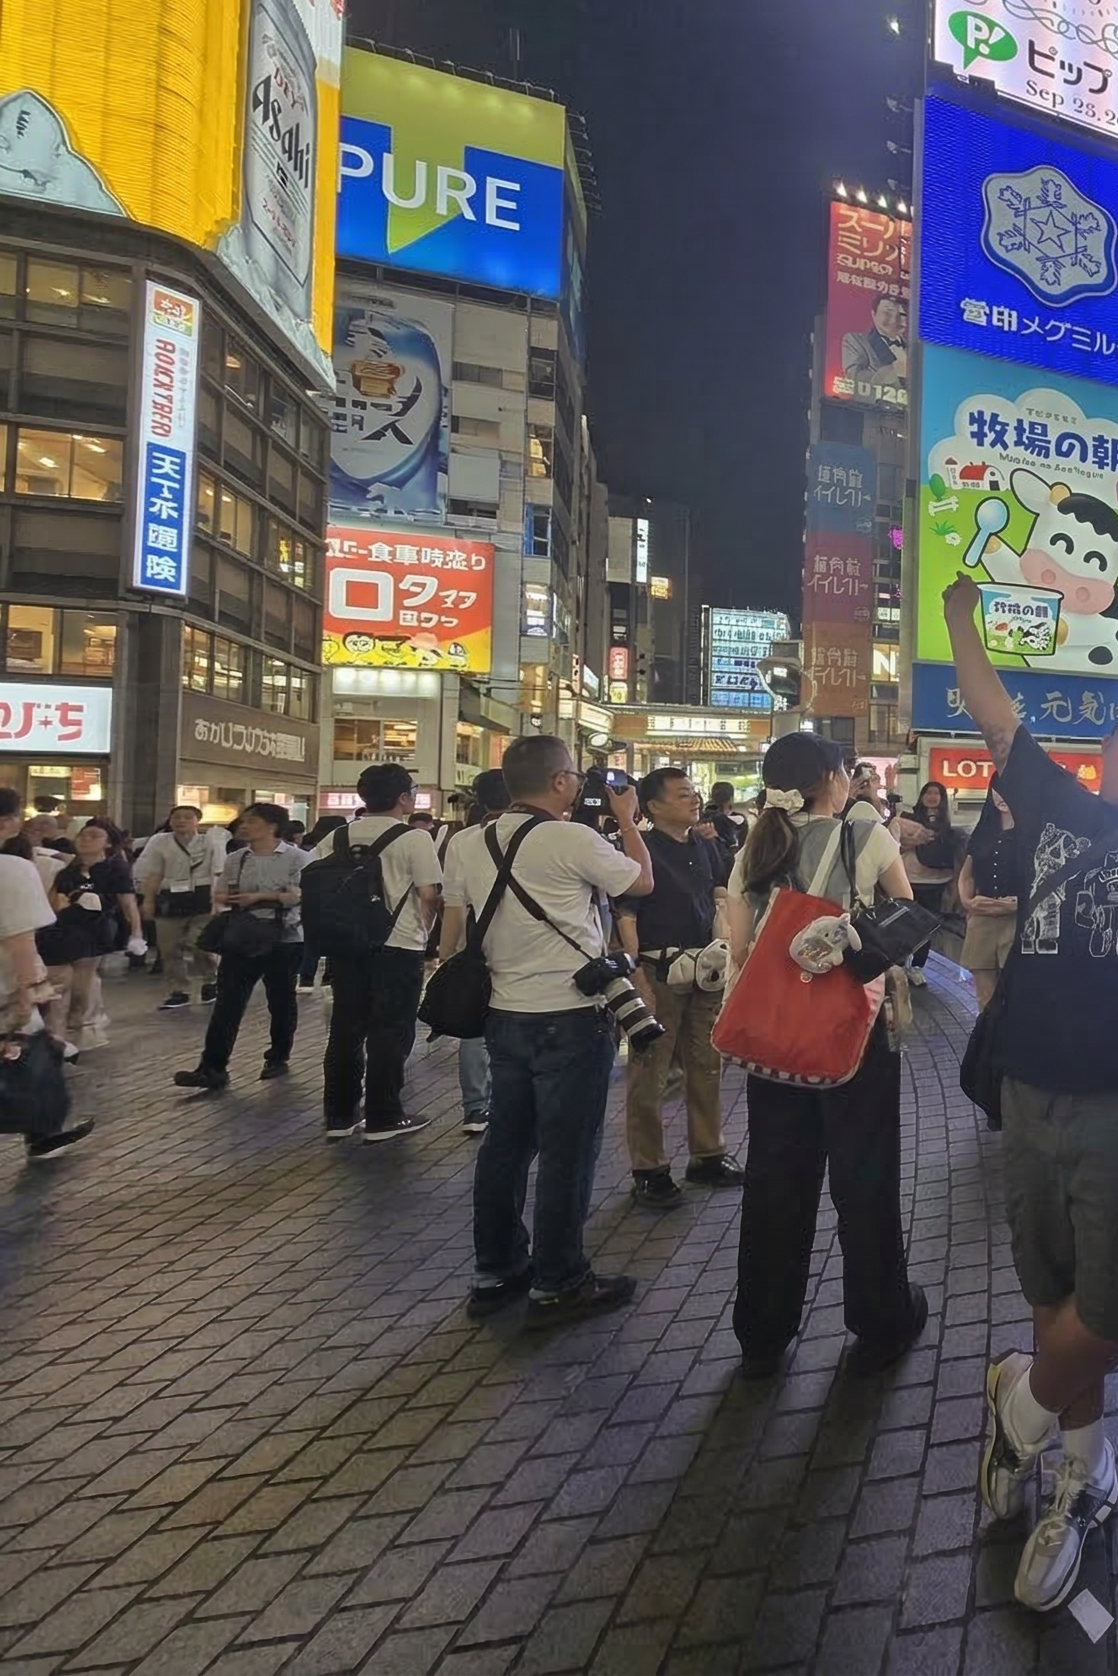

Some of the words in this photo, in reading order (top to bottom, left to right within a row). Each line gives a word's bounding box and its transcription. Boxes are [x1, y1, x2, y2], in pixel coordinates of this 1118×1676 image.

[1026, 79, 1065, 109] Sep
[1028, 38, 1113, 95] ピップ
[252, 74, 310, 190] Asahi
[336, 142, 521, 232] PURE
